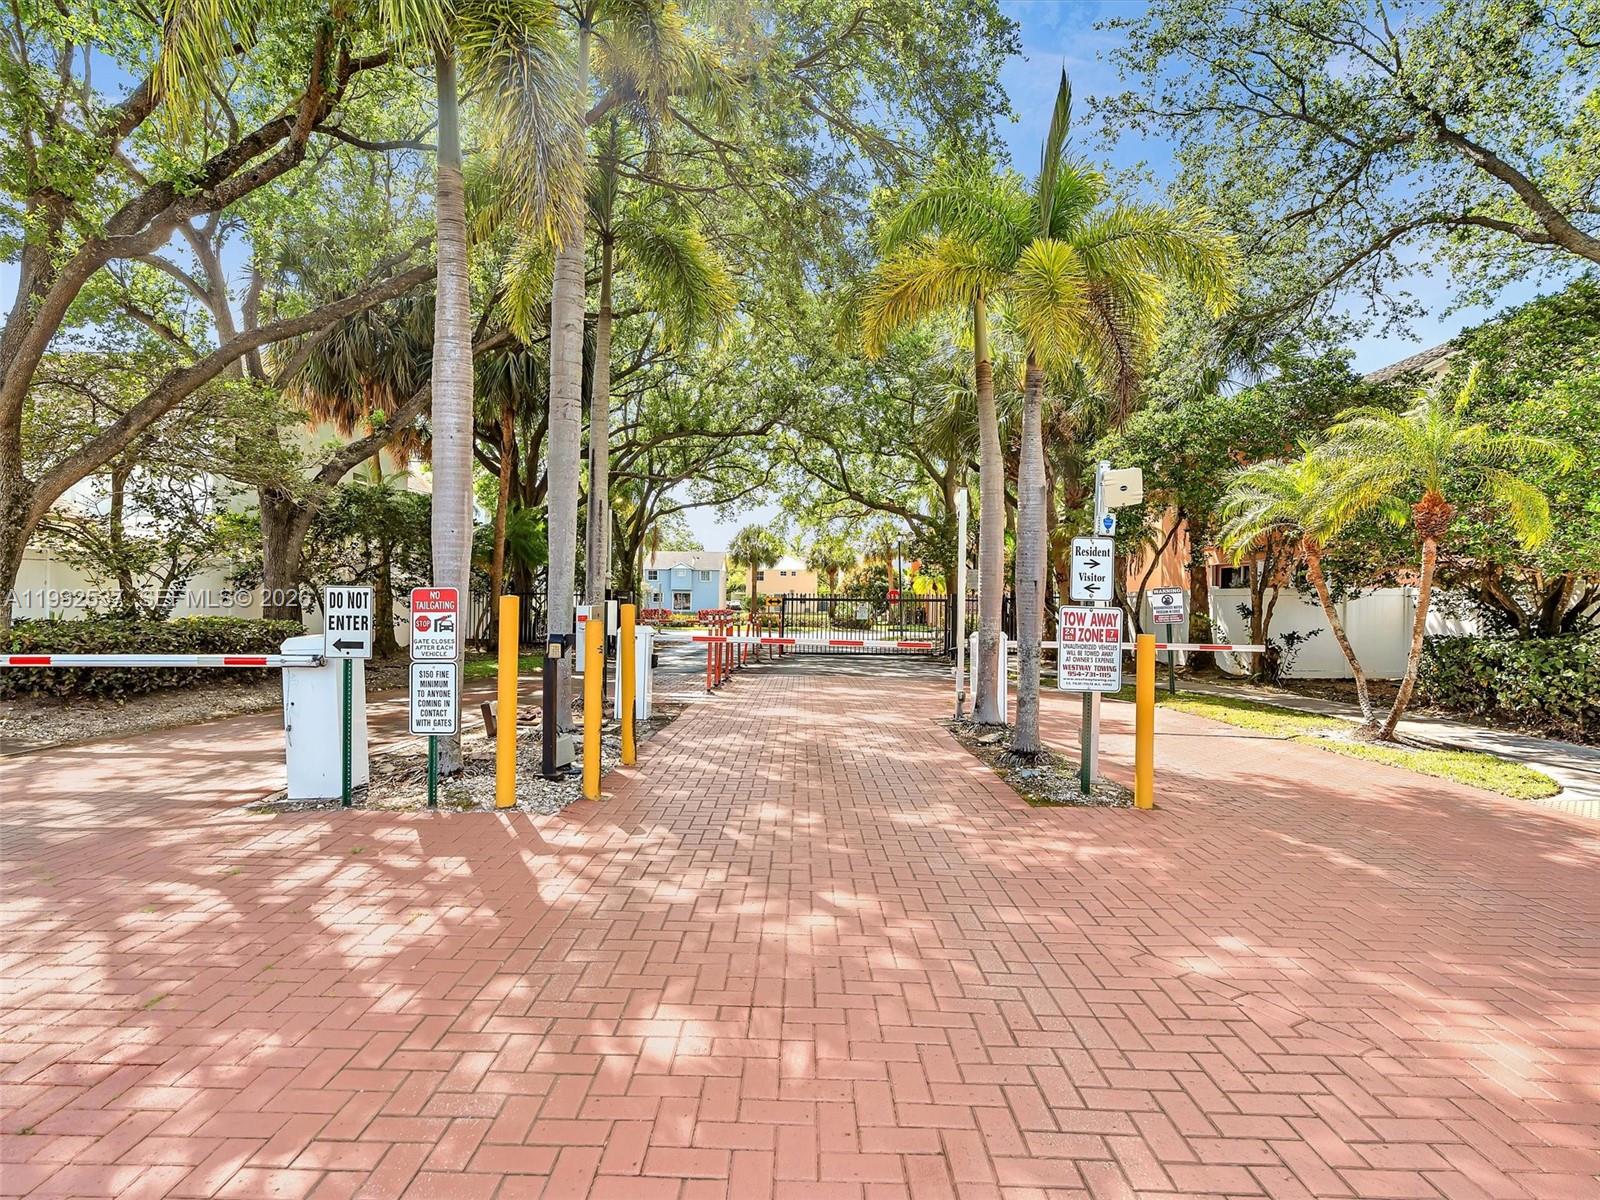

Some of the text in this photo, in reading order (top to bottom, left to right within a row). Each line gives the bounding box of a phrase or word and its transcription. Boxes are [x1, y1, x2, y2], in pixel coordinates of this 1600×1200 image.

[1075, 546, 1110, 557] Resident
[1078, 572, 1106, 582] Visitor
[429, 590, 440, 600] NO
[329, 591, 369, 609] DO NOT
[415, 601, 455, 610] TAILGATING
[328, 615, 369, 631] ENTER
[1063, 611, 1119, 627] TOW AWAY
[1077, 628, 1104, 642] ZONE
[418, 670, 450, 679] $150 FINE
[420, 680, 448, 688] MINIMUM
[417, 689, 451, 698] TO ANYONE
[417, 699, 451, 707] COMING IN
[420, 709, 448, 717] CONTACT
[415, 718, 452, 727] WITH GATES
